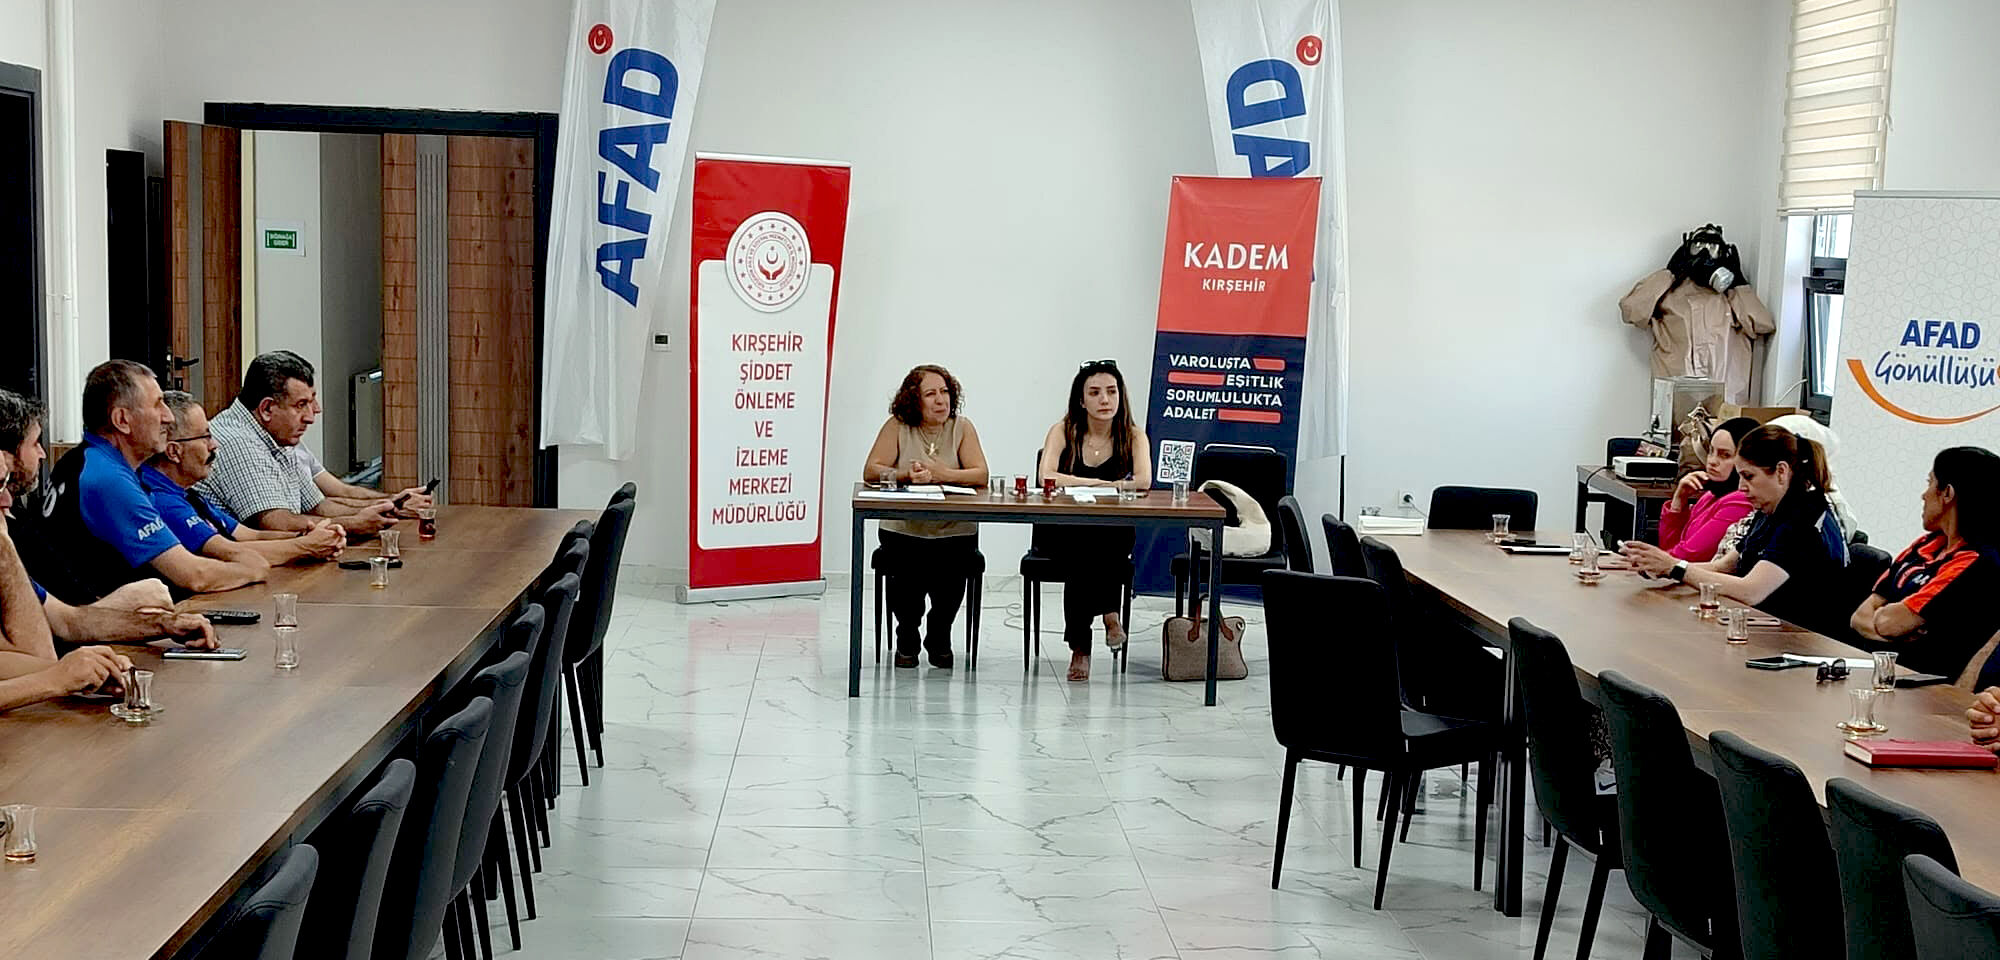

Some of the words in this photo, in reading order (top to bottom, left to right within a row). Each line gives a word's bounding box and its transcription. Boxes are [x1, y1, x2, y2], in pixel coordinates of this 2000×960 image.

[596, 48, 679, 308] AFAD
[1183, 242, 1289, 270] KADEM
[1202, 277, 1266, 294] KIRŞEHİR
[731, 331, 803, 355] KIRŞEHİR
[1900, 319, 1981, 349] AFAD
[739, 360, 793, 384] ŞİDDET
[1169, 354, 1251, 370] VAROLUŞTA
[1875, 351, 1995, 388] Gönüllüsü
[1226, 374, 1284, 389] EŞİTLİK
[734, 388, 796, 410] ÖNLEME
[1166, 388, 1283, 407] SORUMLULUKTA
[1163, 405, 1216, 420] ADALET
[754, 420, 774, 438] VE
[735, 446, 788, 467] İZLEME
[728, 473, 793, 496] MERKEZİ
[711, 500, 807, 525] MÜDÜRLÜĞÜ
